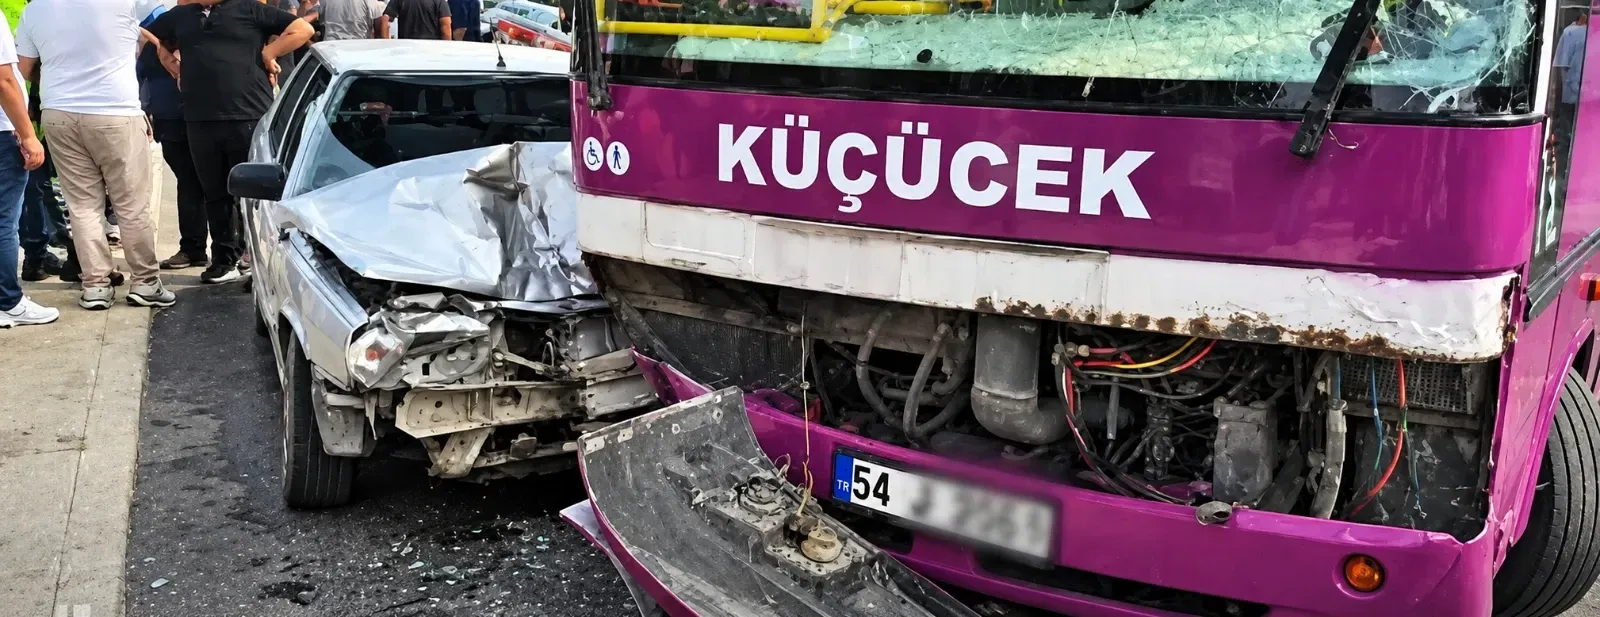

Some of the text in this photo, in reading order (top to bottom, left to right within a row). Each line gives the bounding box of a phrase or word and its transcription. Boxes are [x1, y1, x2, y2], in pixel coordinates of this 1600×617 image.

[718, 114, 1155, 219] KÜÇÜCEK
[837, 479, 849, 492] TR
[853, 465, 890, 506] 54
